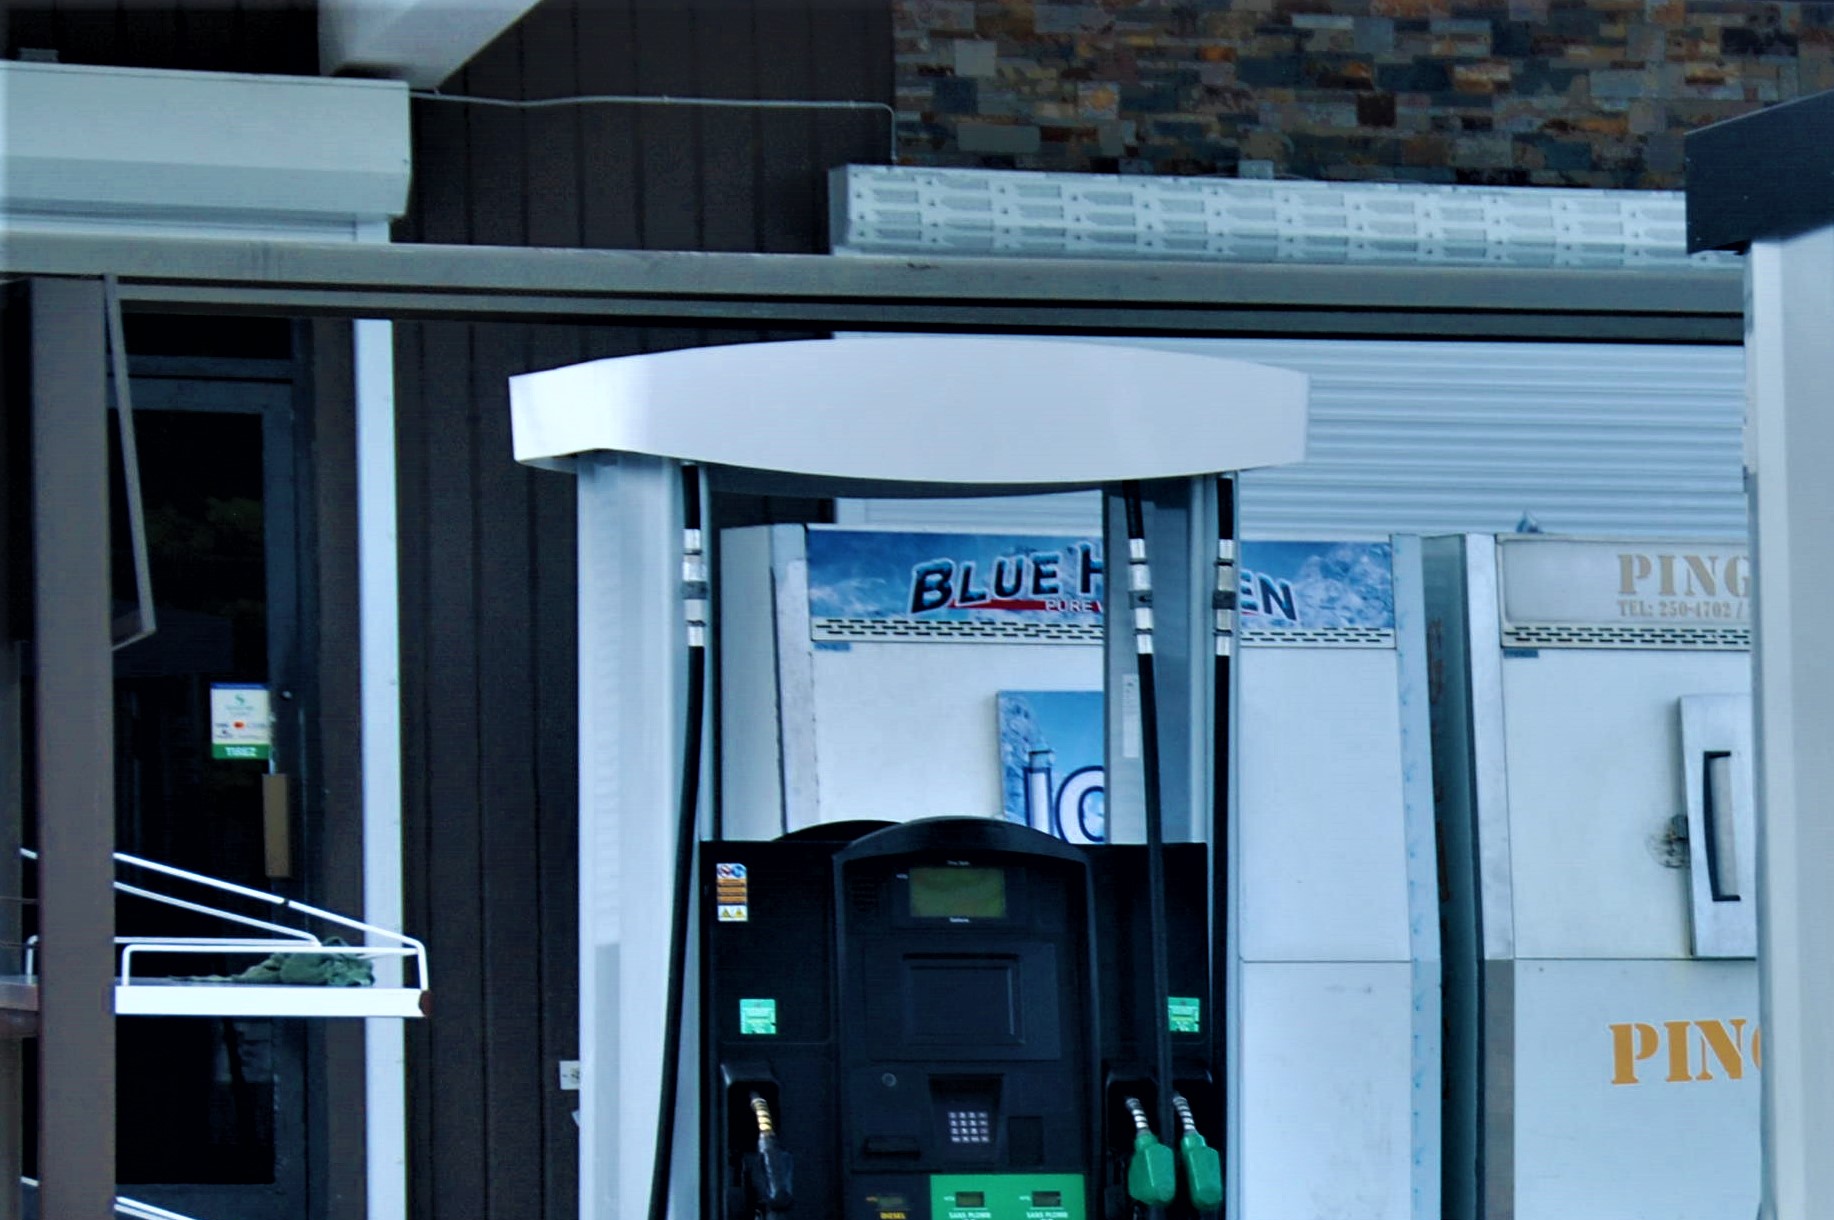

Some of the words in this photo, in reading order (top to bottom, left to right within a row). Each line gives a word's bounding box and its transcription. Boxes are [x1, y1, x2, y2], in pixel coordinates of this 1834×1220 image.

[909, 551, 1062, 615] BLUE
[1045, 600, 1094, 613] PURE
[1618, 600, 1654, 617] TEL:
